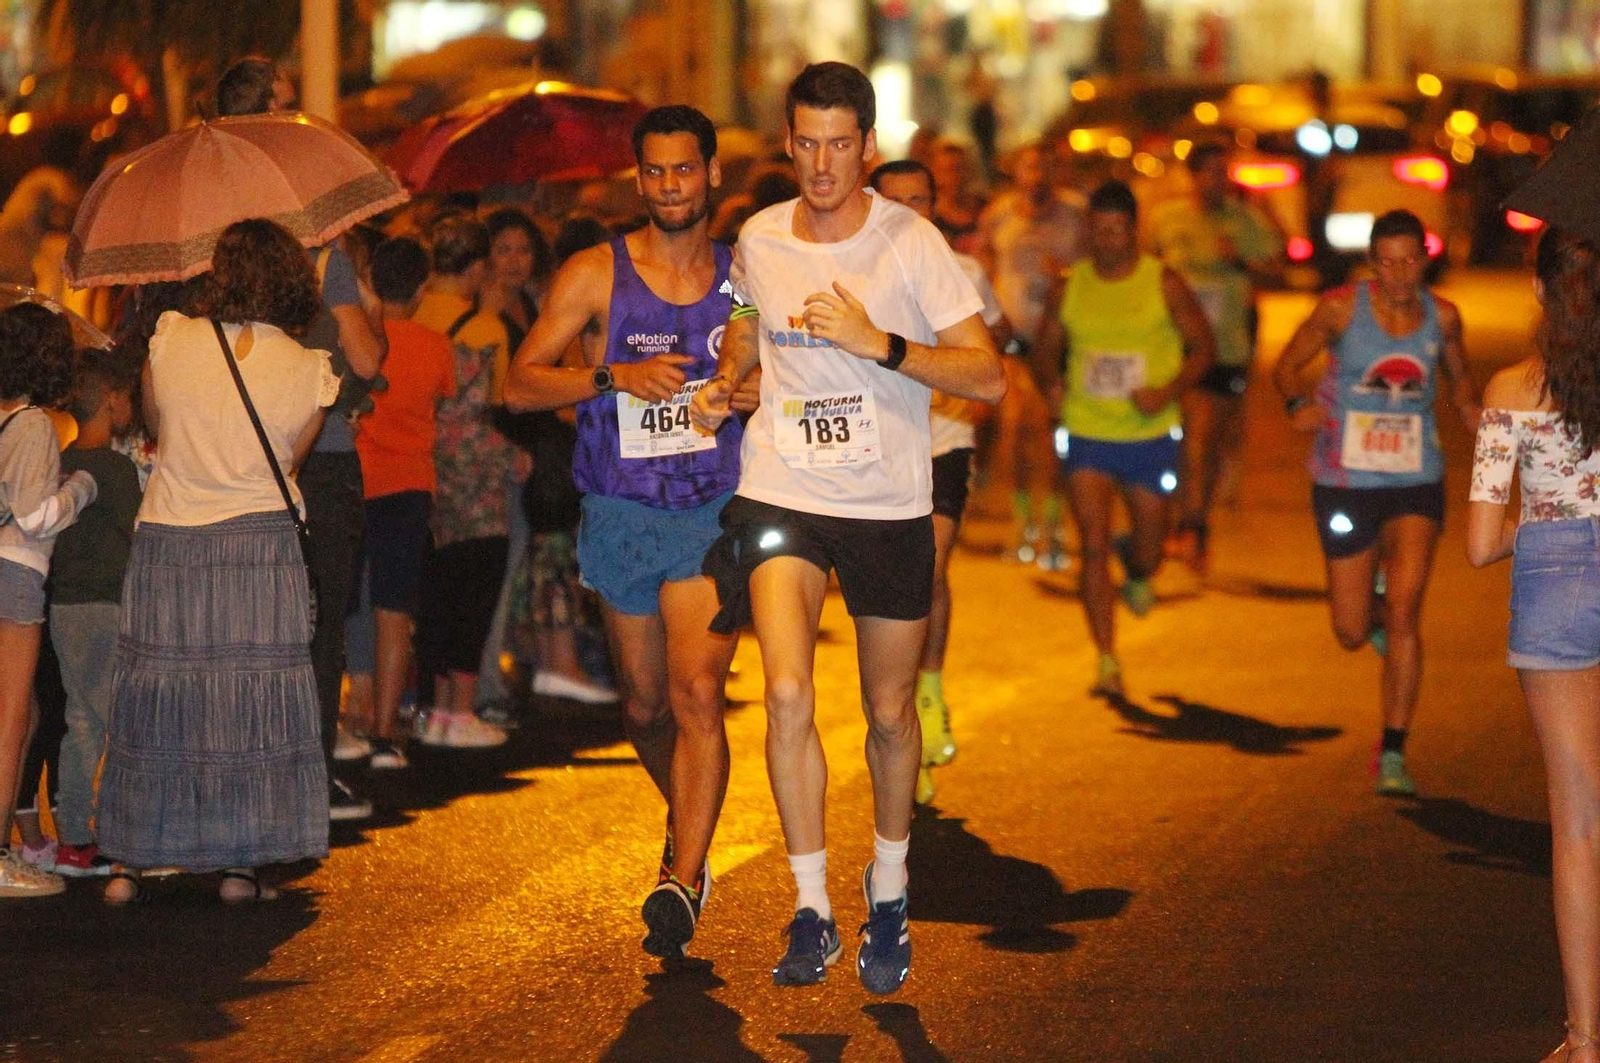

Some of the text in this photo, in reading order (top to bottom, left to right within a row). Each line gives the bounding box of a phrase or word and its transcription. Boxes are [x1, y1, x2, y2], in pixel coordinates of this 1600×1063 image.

[626, 333, 678, 345] eMotion
[637, 344, 670, 353] running
[804, 394, 863, 409] NOCTURNA
[803, 405, 862, 419] DE HUELVA
[640, 405, 690, 434] 464
[797, 416, 850, 445] 183
